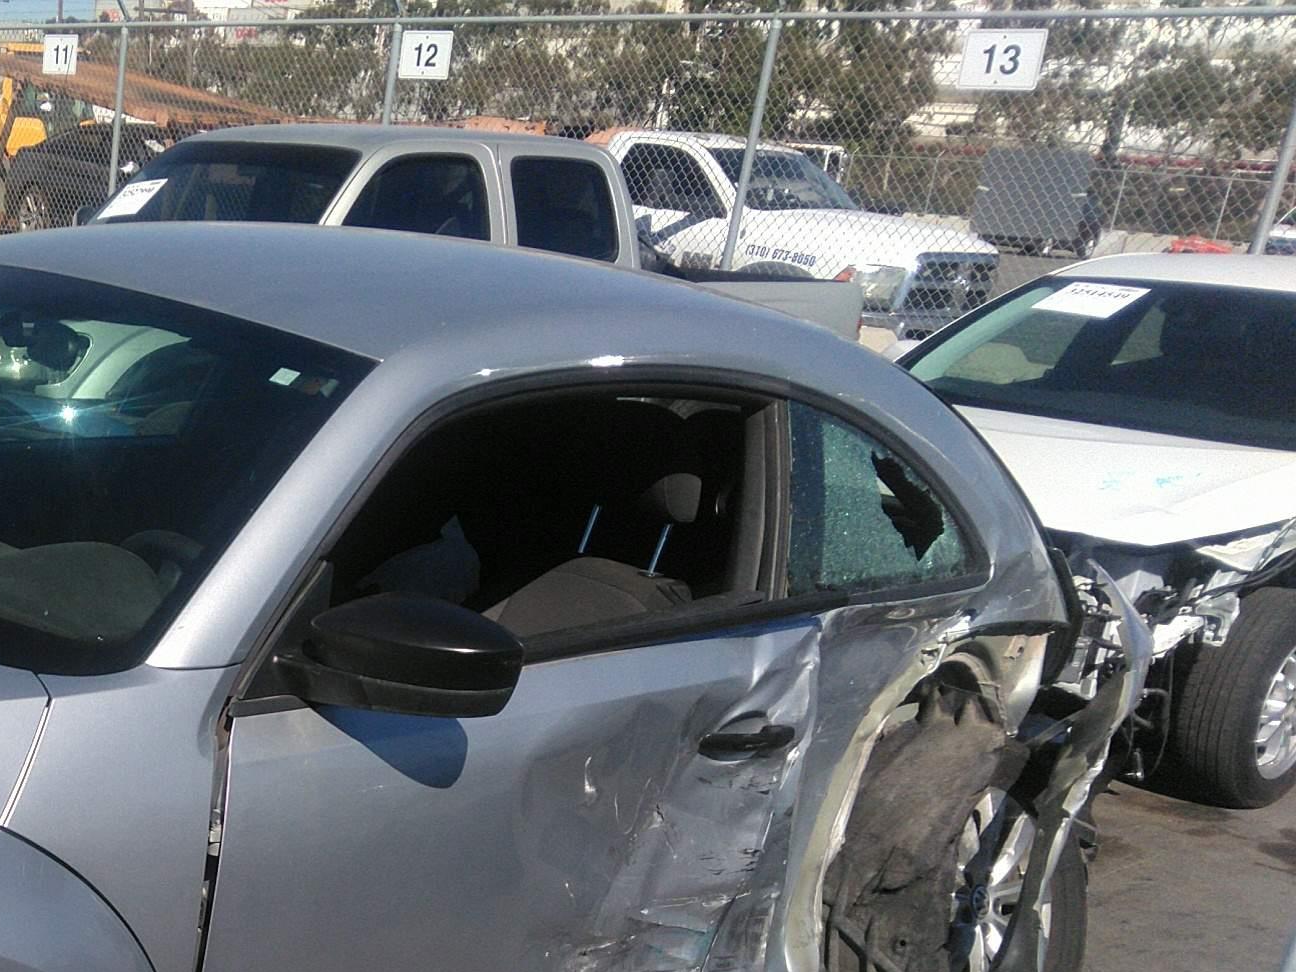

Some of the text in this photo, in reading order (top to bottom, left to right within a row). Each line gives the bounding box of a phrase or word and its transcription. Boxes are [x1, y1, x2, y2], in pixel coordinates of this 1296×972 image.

[53, 44, 68, 65] 11
[414, 43, 438, 67] 12
[983, 44, 1022, 75] 13
[745, 244, 770, 258] (310)
